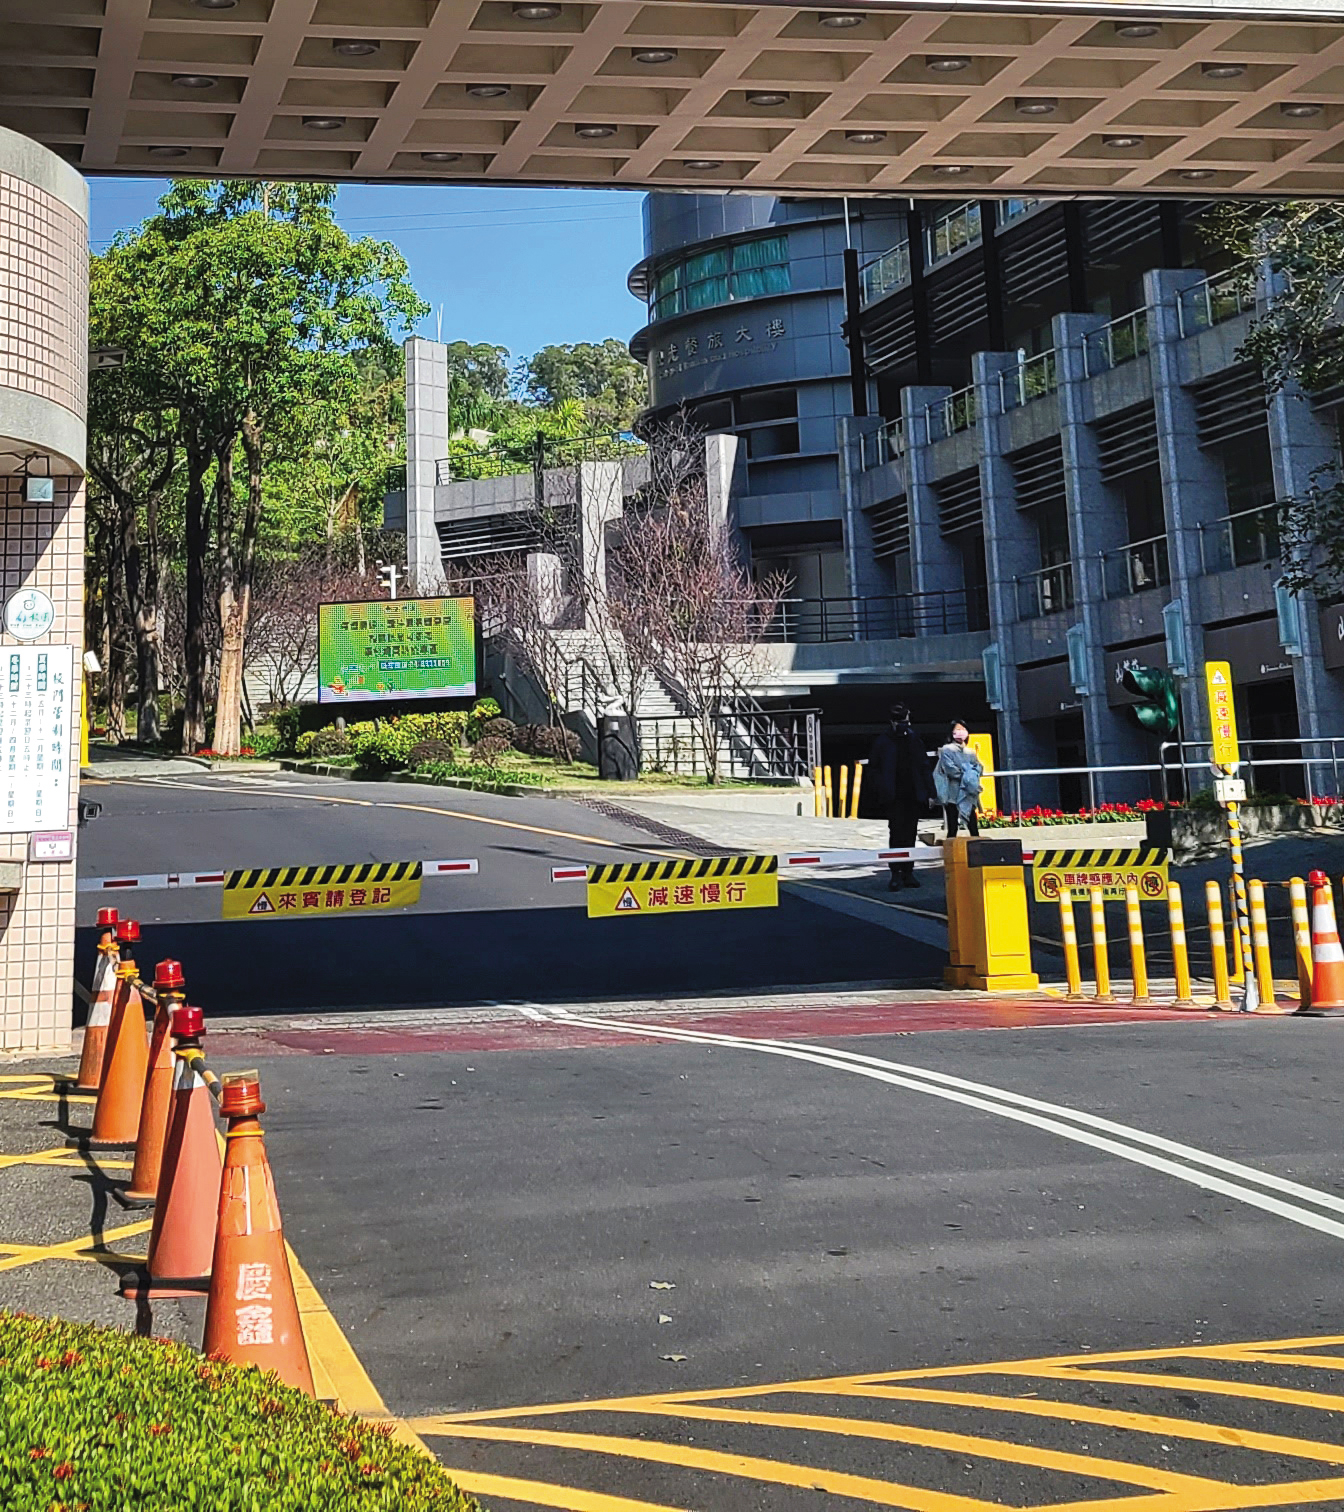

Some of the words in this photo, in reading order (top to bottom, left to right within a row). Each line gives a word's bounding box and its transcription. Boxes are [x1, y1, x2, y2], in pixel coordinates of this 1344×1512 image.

[278, 888, 391, 910] 來賓請登記
[647, 882, 747, 907] 減速慢行
